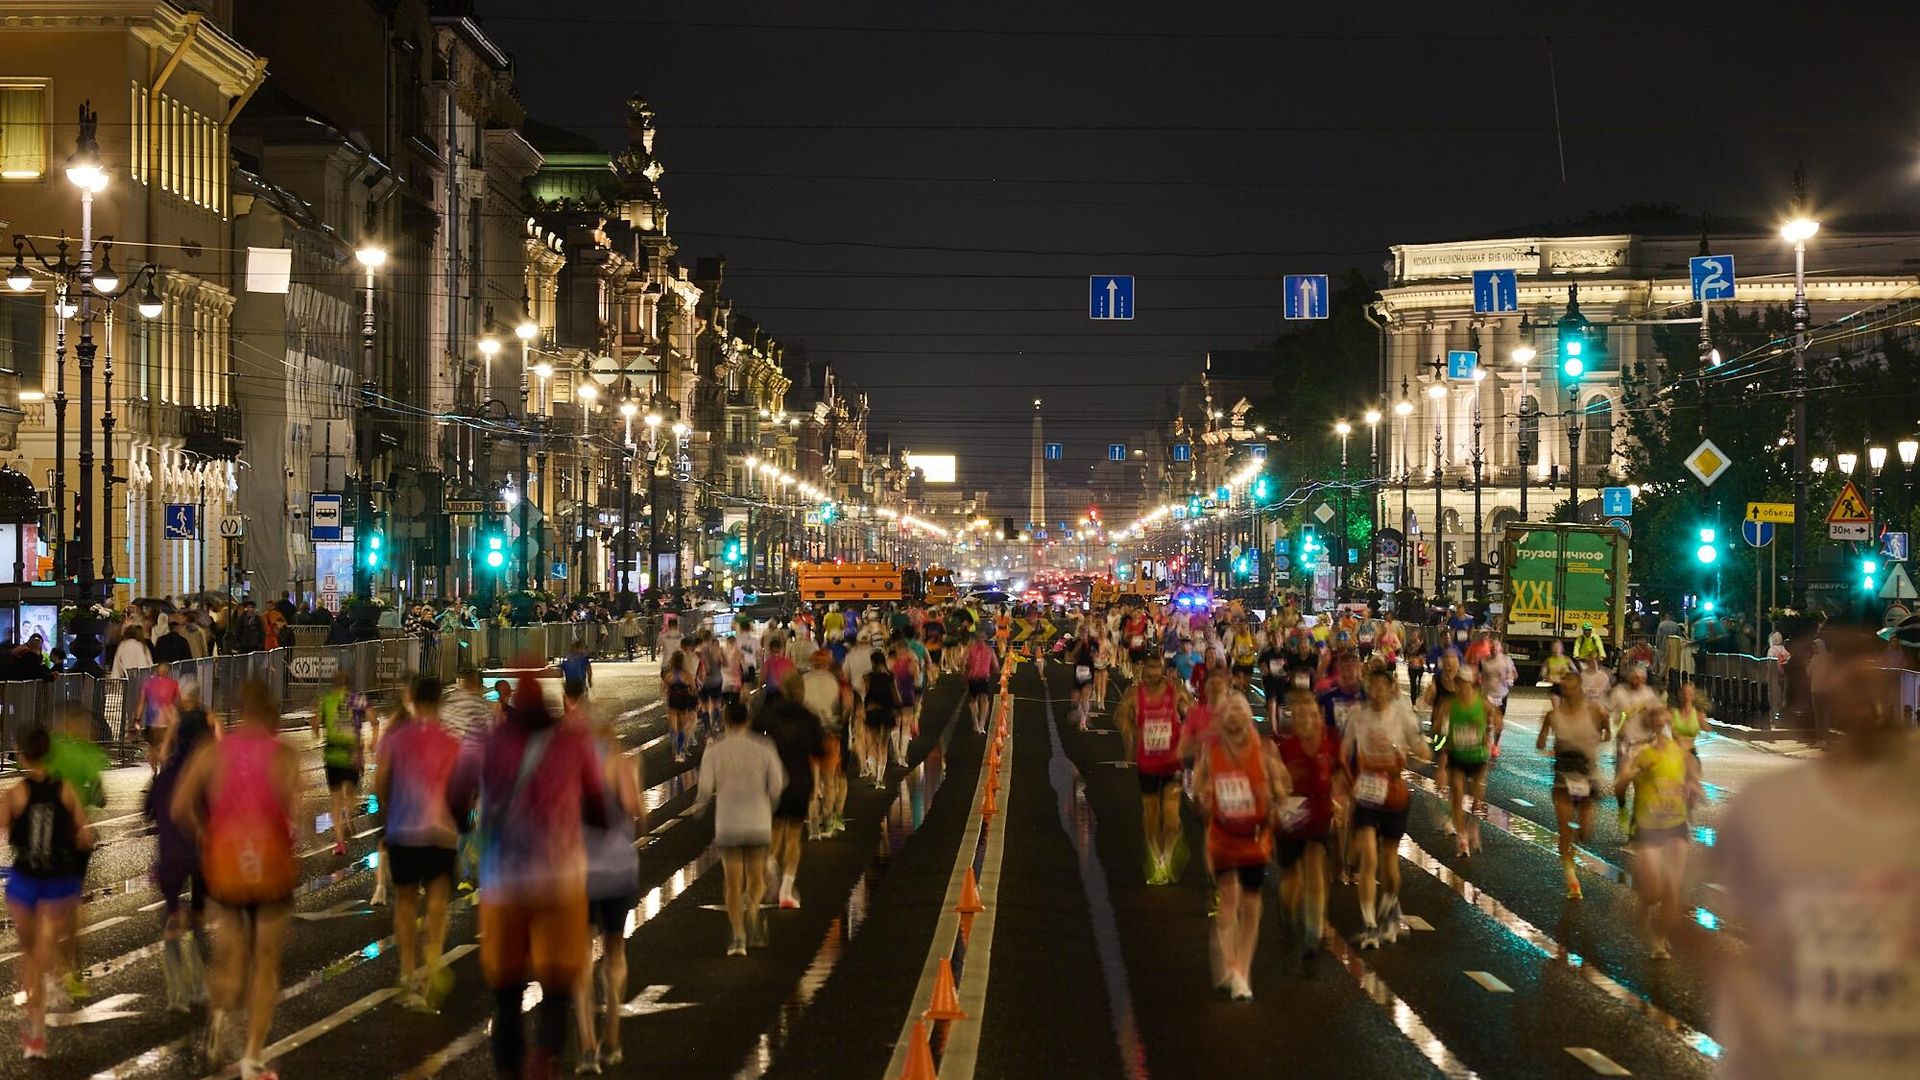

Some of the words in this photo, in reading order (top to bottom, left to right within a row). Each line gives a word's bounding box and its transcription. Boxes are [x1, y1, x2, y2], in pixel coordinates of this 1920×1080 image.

[1488, 251, 1536, 262] БИБЛИОТЕКА
[1763, 508, 1793, 518] объезд
[1516, 549, 1604, 561] грузовичкоф
